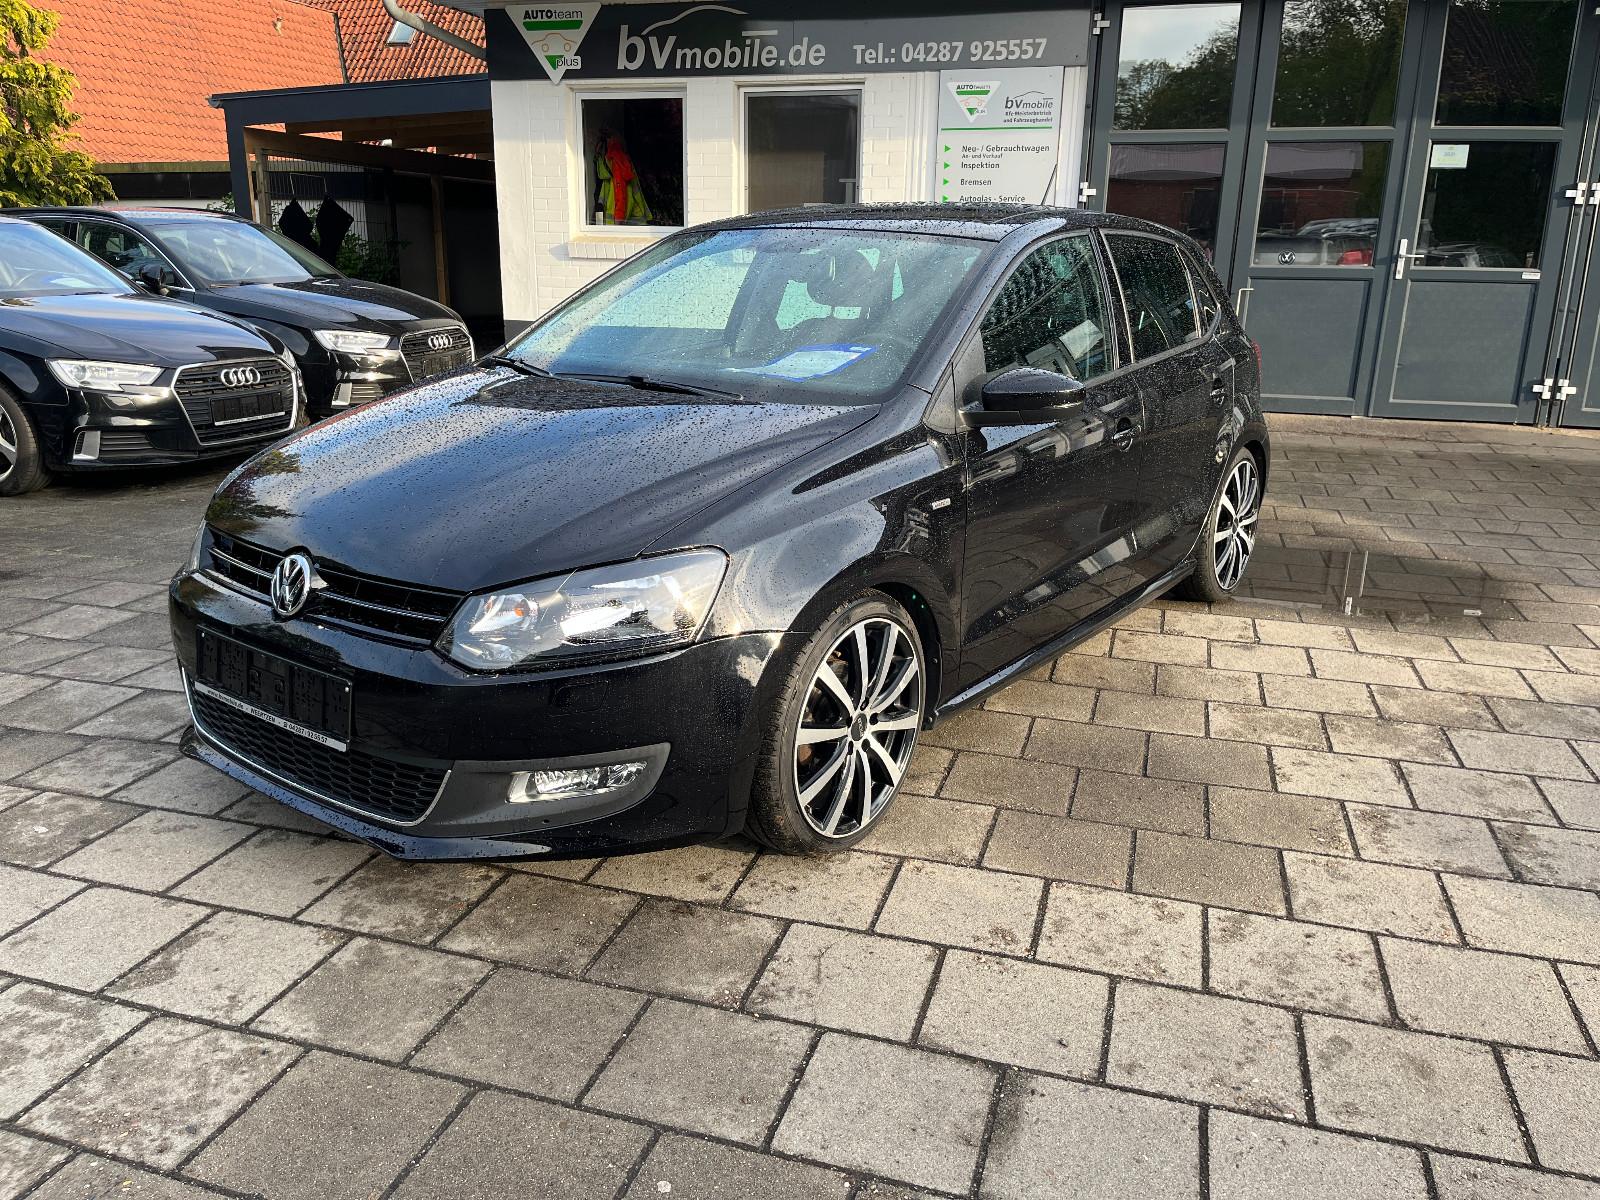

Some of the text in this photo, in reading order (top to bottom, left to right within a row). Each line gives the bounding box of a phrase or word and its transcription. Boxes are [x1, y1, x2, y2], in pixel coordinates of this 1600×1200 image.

[523, 9, 583, 20] AUTOteam
[852, 38, 1048, 64] Tel.: 04287 925557
[556, 56, 579, 69] plus
[961, 145, 980, 153] Neu-
[985, 144, 1050, 153] Gebrauchtwagen
[961, 161, 1000, 170] Inspektion
[960, 178, 992, 186] Bremsen
[960, 195, 992, 203] Autoglas
[998, 195, 1026, 203] Service
